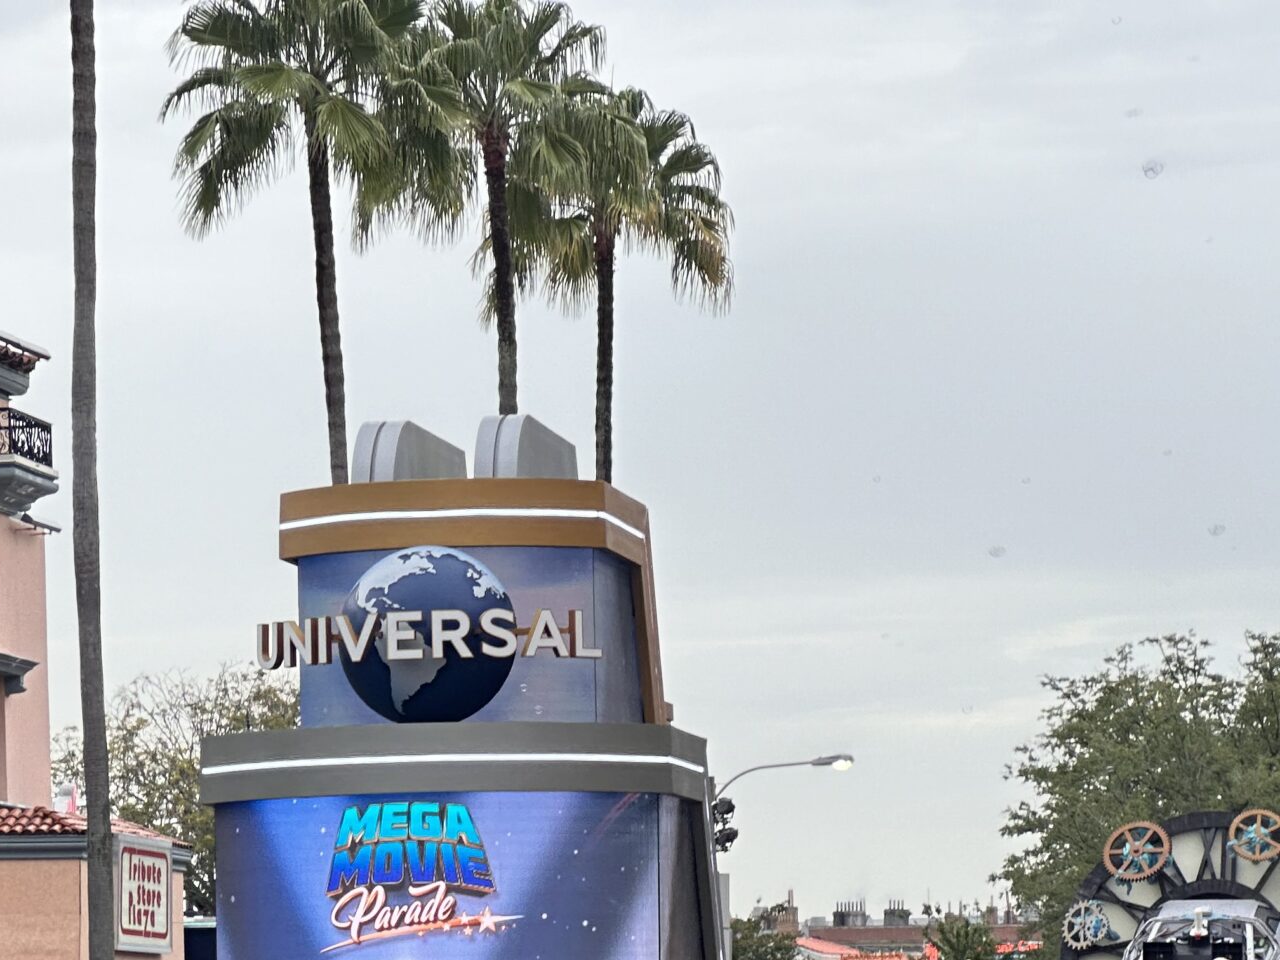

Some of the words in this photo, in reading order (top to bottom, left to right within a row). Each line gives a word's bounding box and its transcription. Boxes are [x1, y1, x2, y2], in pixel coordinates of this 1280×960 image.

[255, 608, 603, 670] UNIVERSAL
[335, 802, 484, 851] MEGA
[127, 848, 162, 885] Tribute
[326, 840, 498, 897] MOVIE
[137, 884, 162, 908] Store
[331, 881, 456, 944] Parade
